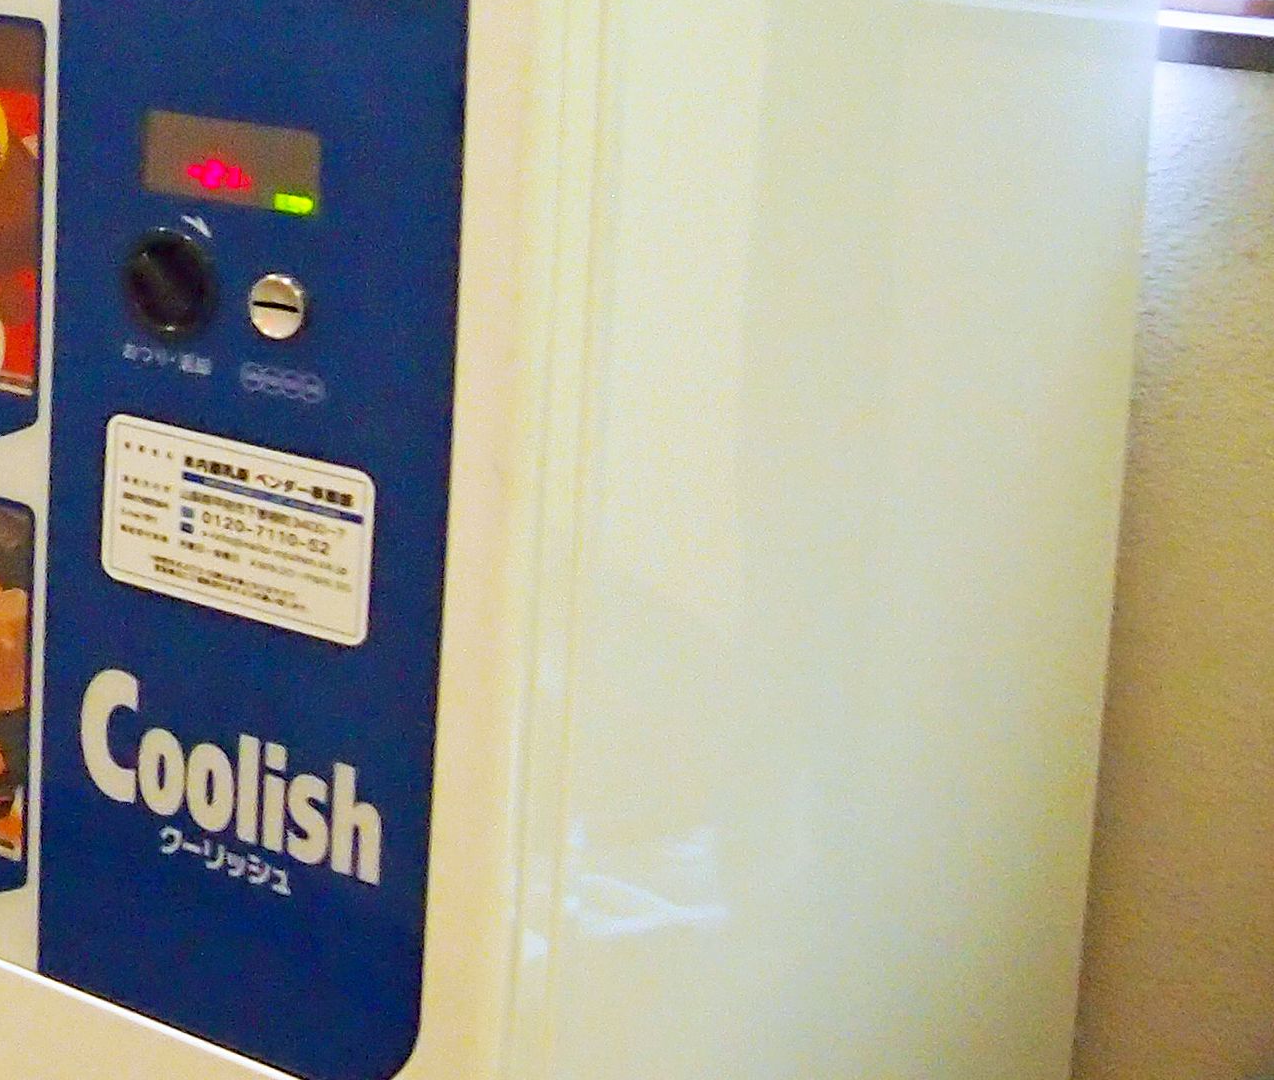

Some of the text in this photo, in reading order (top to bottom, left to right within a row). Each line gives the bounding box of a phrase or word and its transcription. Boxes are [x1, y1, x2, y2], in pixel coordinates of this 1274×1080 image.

[80, 669, 382, 886] Coolish
[159, 825, 291, 897] クーリッシュ
